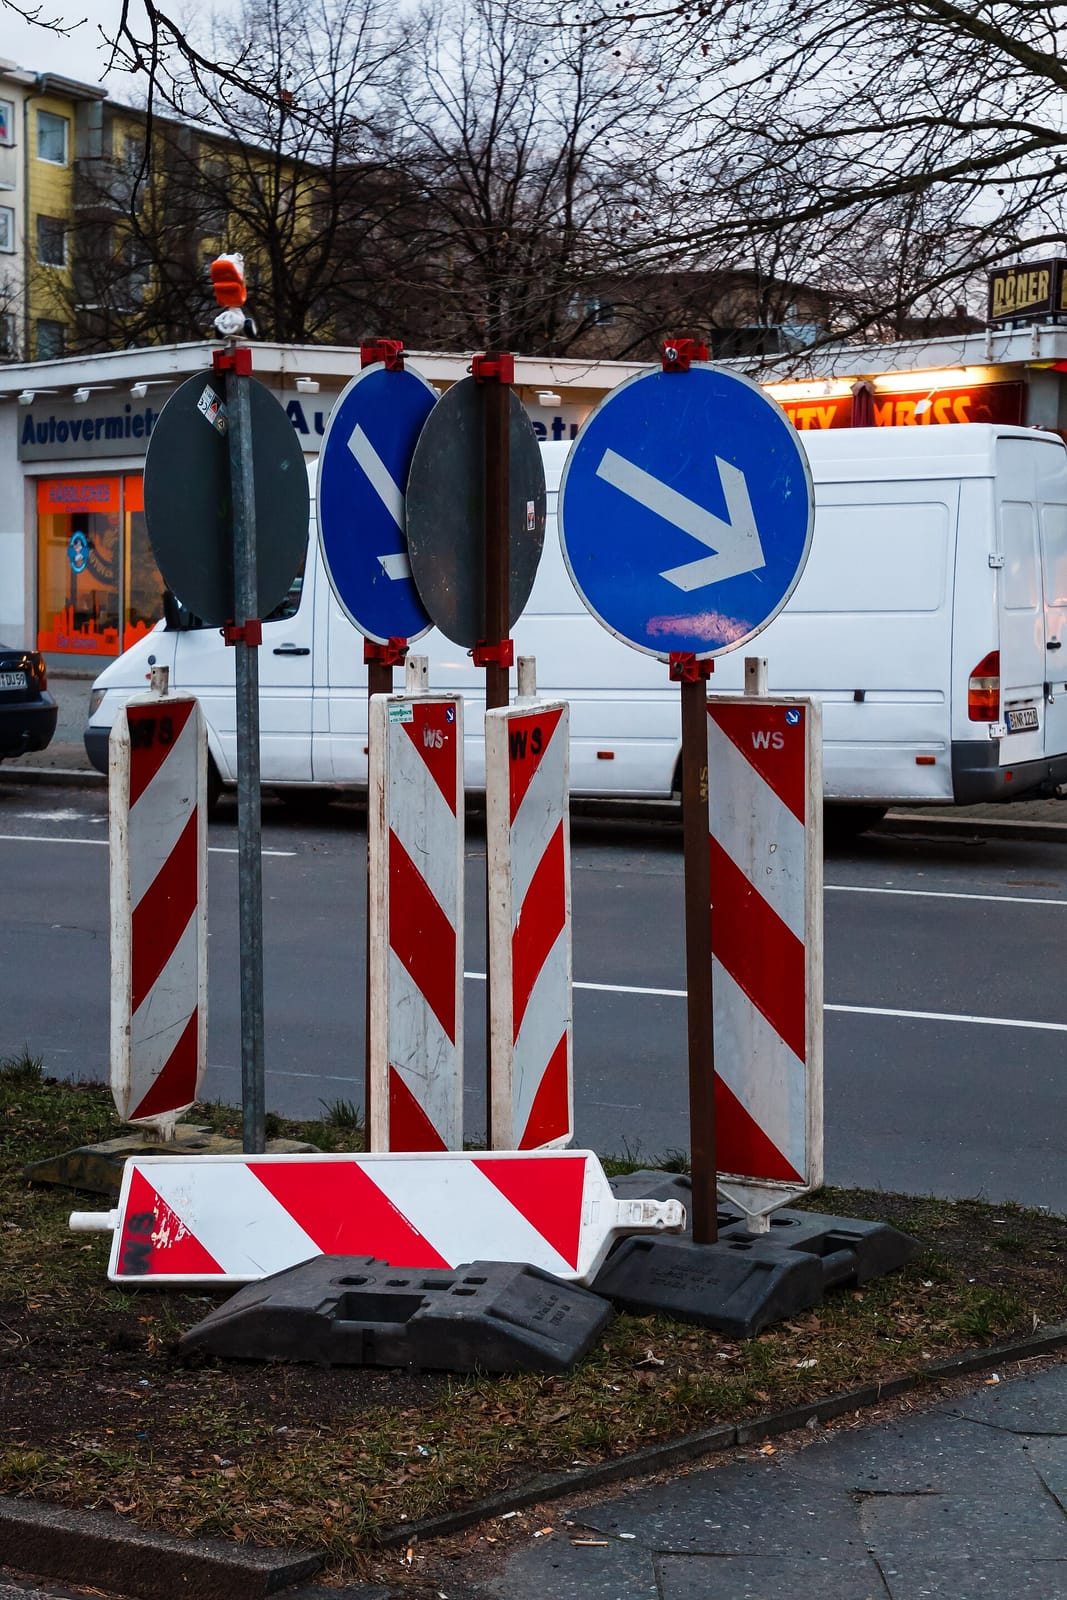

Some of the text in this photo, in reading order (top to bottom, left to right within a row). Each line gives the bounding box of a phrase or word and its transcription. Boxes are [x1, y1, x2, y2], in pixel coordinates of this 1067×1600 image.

[992, 269, 1049, 311] DÖNER
[786, 396, 972, 430] ITY MBISS
[510, 727, 542, 761] WS
[751, 730, 785, 750] WS
